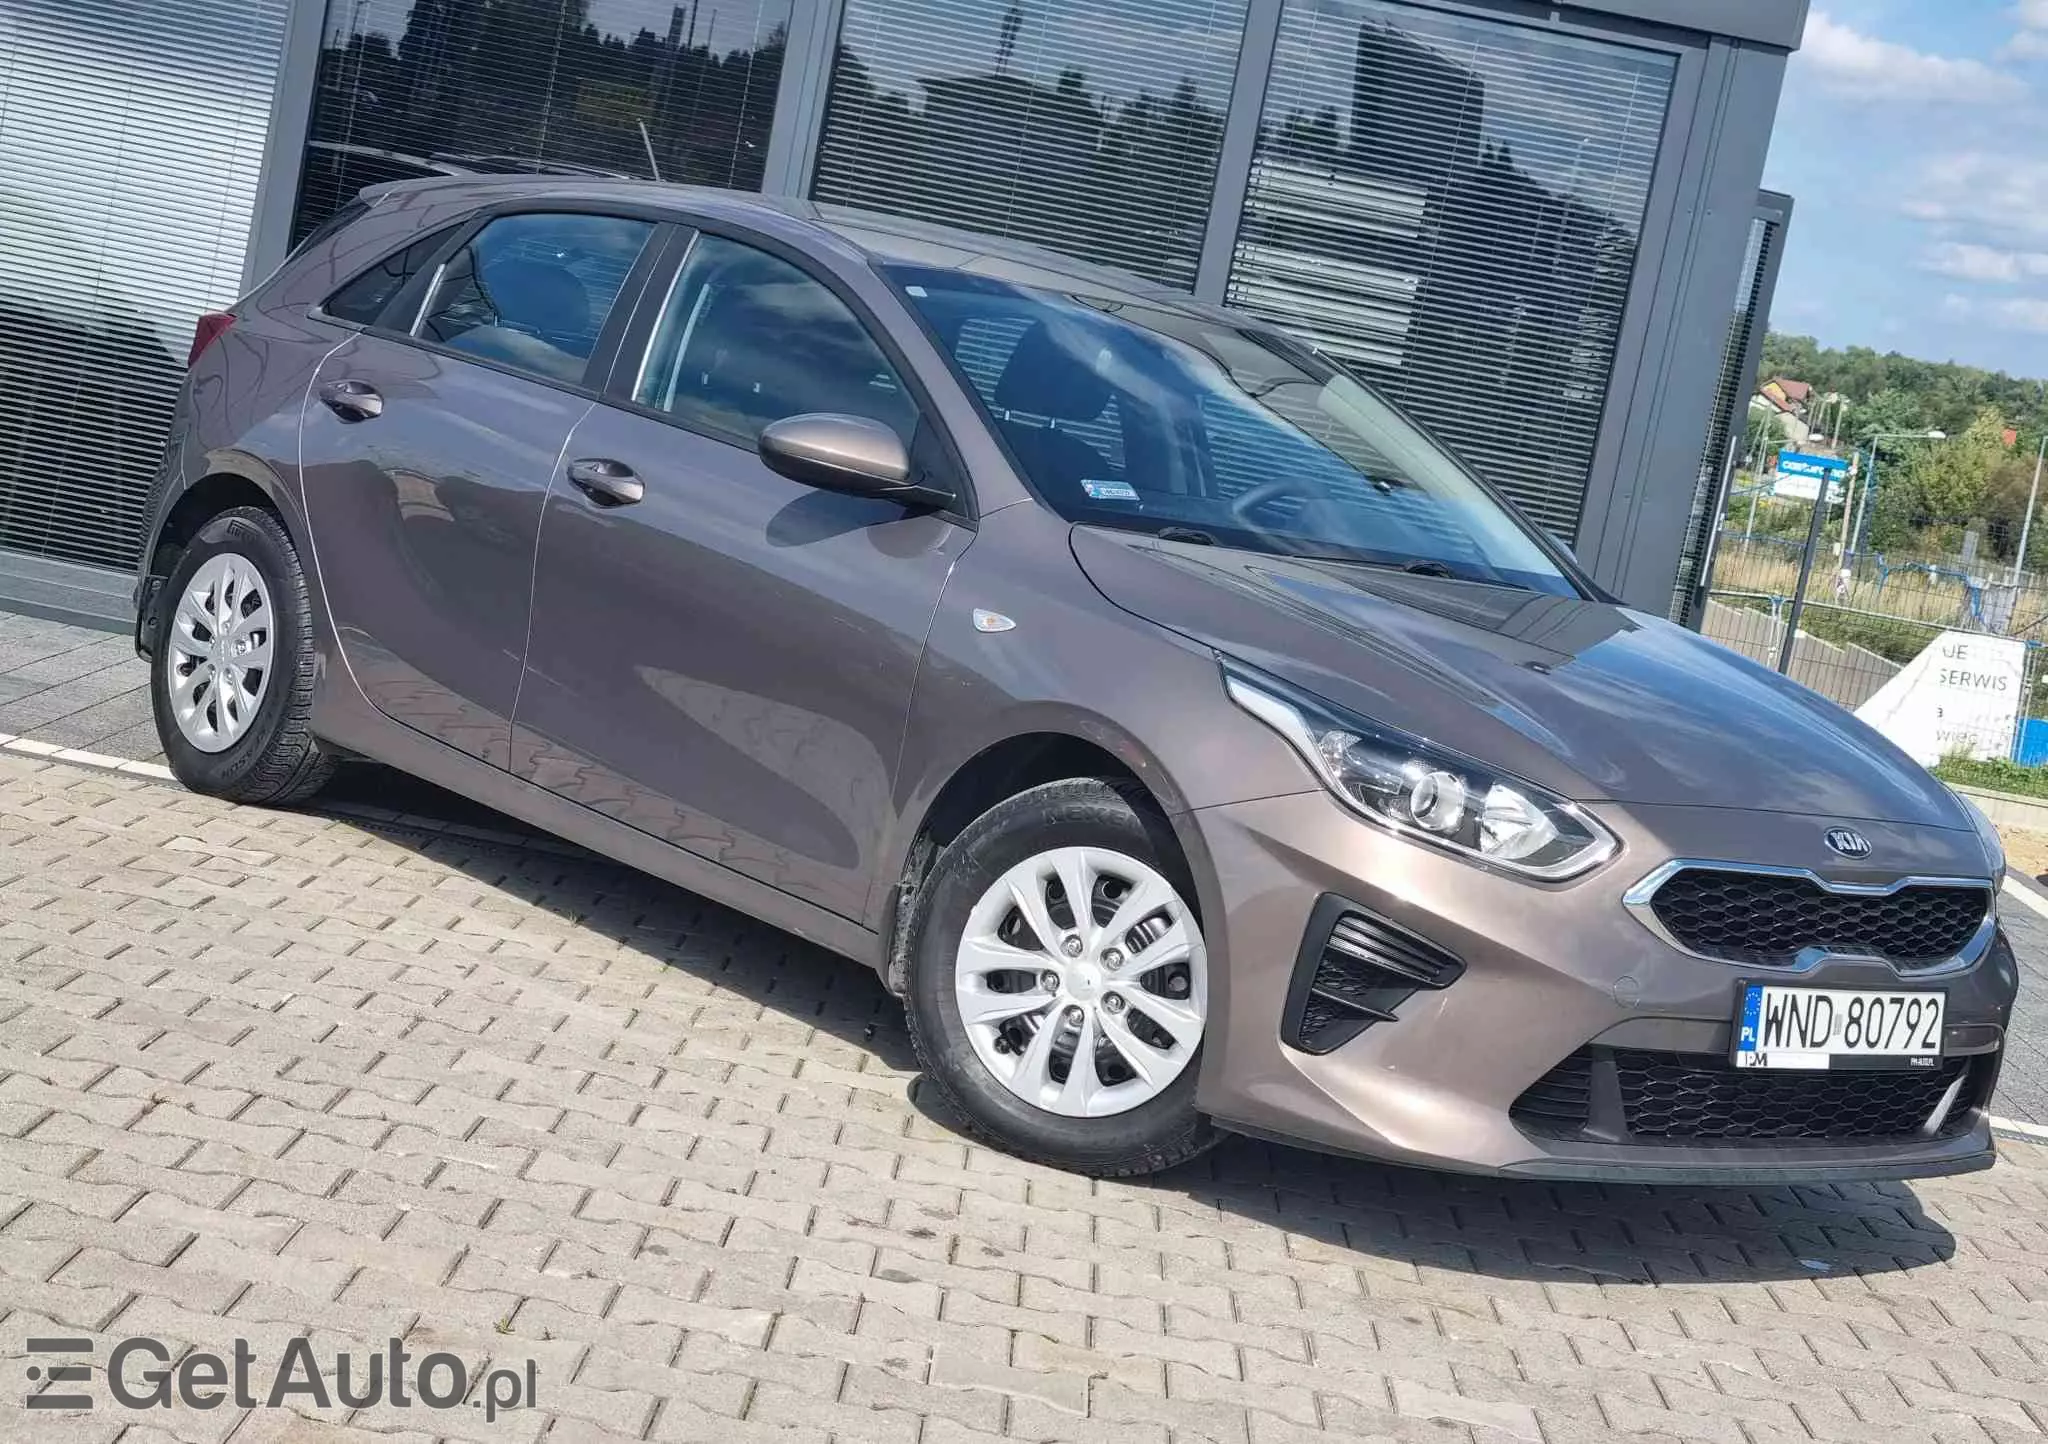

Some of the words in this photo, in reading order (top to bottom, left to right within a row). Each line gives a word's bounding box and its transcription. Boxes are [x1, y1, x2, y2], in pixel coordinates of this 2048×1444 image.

[1940, 668, 2008, 691] SERWIS
[1830, 831, 1869, 852] KIA
[1763, 992, 1834, 1049] WND
[1844, 996, 1940, 1050] 80792
[1740, 1026, 1756, 1042] PL
